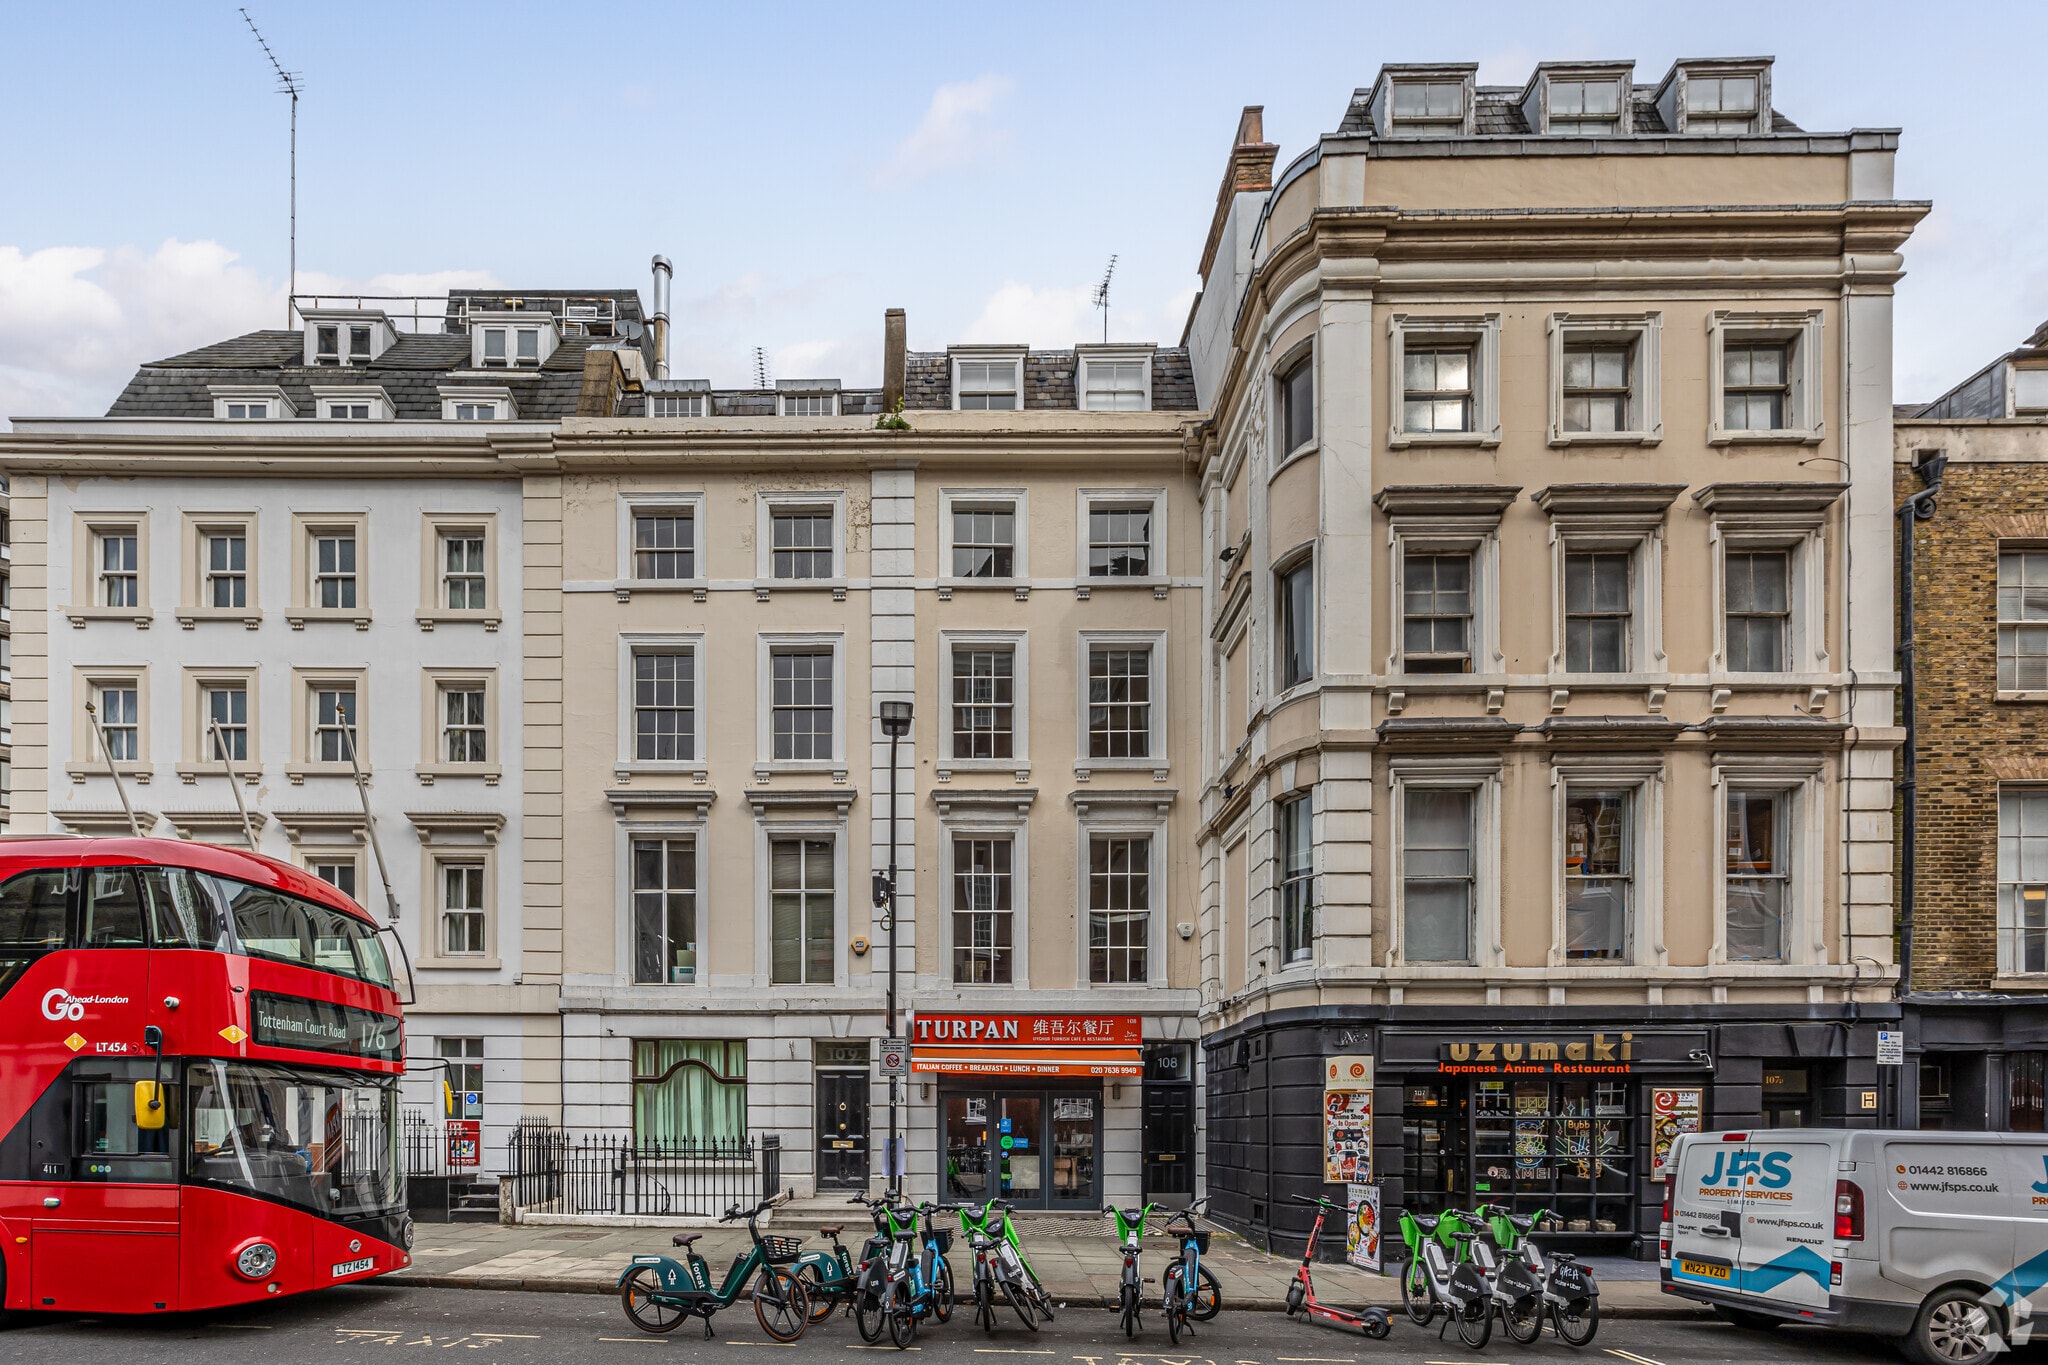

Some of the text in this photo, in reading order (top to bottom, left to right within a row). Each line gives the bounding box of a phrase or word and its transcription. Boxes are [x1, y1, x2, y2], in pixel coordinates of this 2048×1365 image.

[42, 988, 85, 1021] Go
[65, 994, 129, 1004] Ahead-London
[258, 1010, 346, 1039] Tottenham Court Road
[916, 1019, 1019, 1039] TURPAN
[1033, 1019, 1114, 1036] 维吾尔餐厅
[362, 1023, 386, 1050] 176
[96, 1042, 128, 1053] LT454
[1450, 1031, 1633, 1062] uzumaki
[969, 1064, 1004, 1072] BREAKFAST
[1009, 1065, 1031, 1073] LUNCH
[1037, 1065, 1060, 1073] DINNER
[1157, 1057, 1178, 1068] 108
[1437, 1060, 1631, 1075] Japanese Anime Restaurant
[1090, 1066, 1103, 1074] 020
[43, 1164, 57, 1174] 411
[1701, 1151, 1794, 1189] JFS
[1908, 1165, 1988, 1177] 01442 816866
[1910, 1181, 2000, 1193] www.jfsps.co.uk
[1699, 1188, 1793, 1201] PROPERTY SERVICES
[1680, 1210, 1720, 1220] 01442 816866
[1756, 1218, 1824, 1230] www.jfsps.co.uk
[1786, 1236, 1825, 1245] RENAULT
[1684, 1262, 1707, 1275] WN23
[692, 1262, 706, 1289] forest
[1570, 1282, 1581, 1291] Uber
